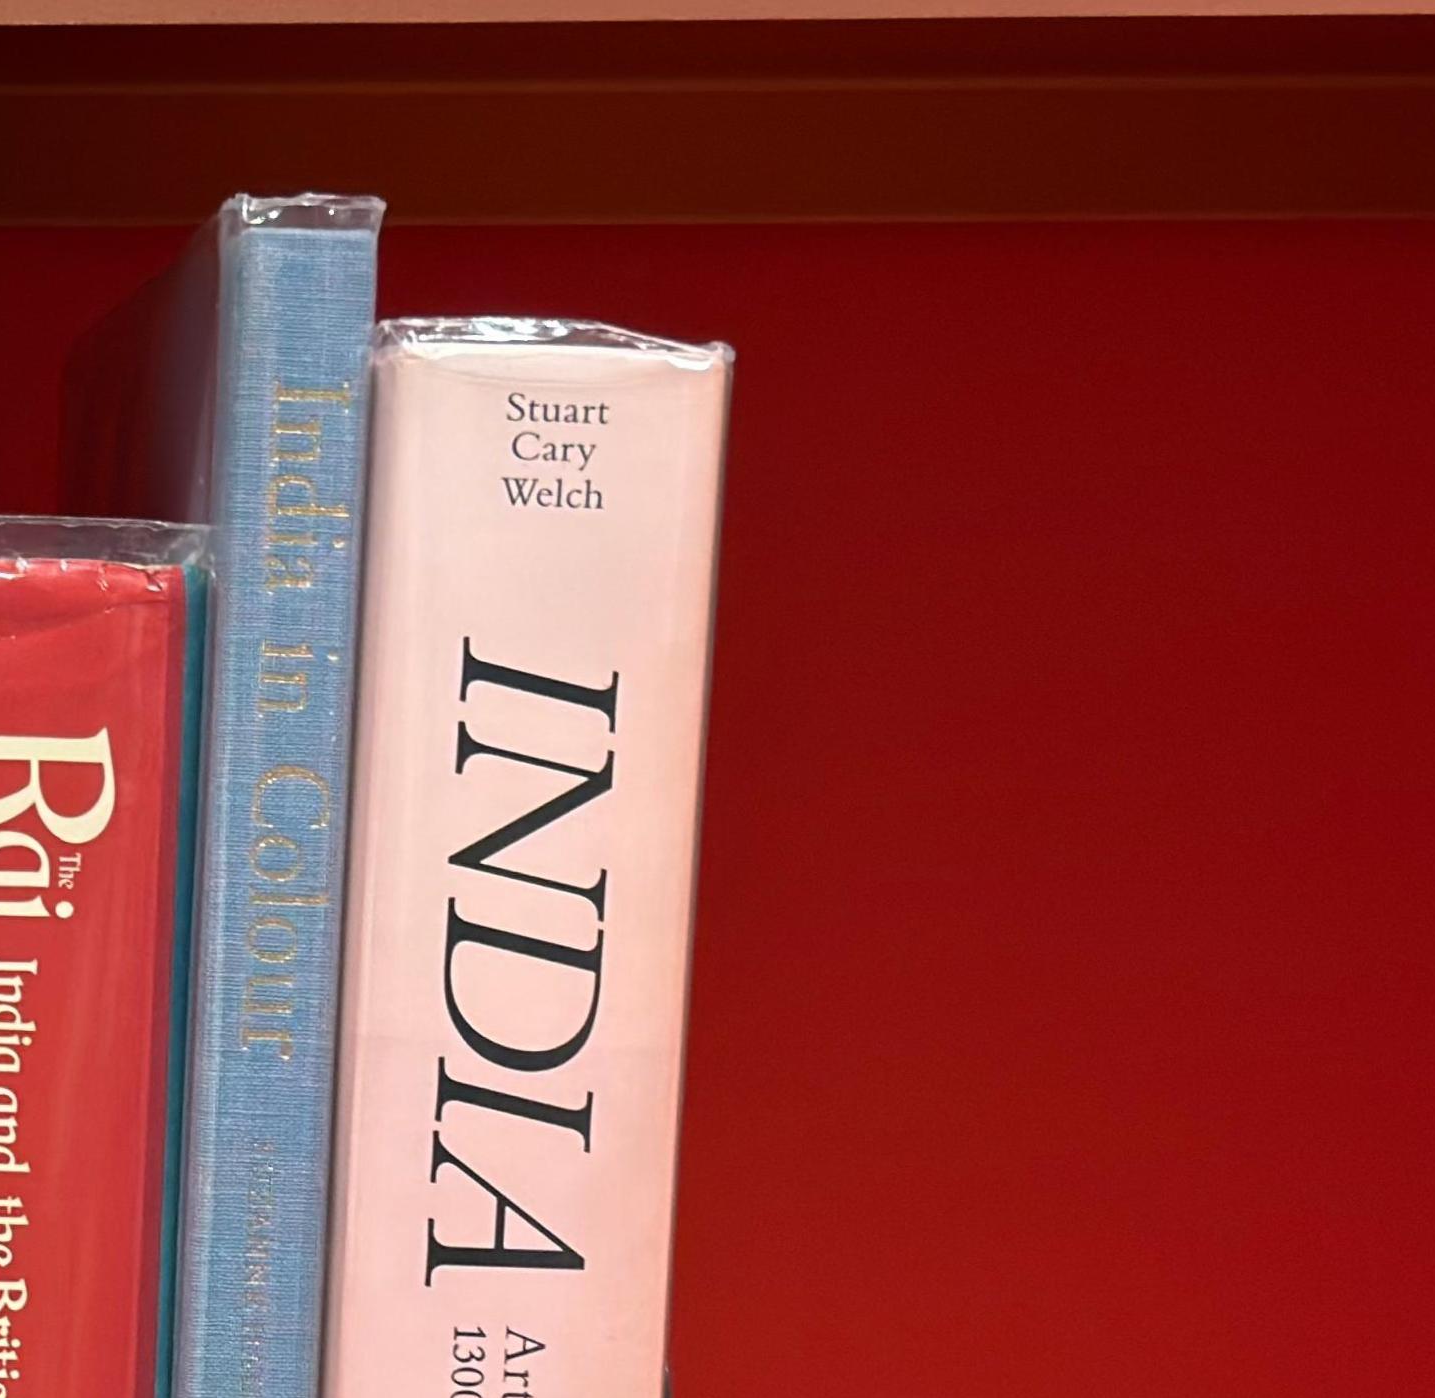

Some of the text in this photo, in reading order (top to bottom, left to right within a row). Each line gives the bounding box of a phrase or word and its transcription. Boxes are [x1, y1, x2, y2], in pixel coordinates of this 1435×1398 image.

[505, 392, 610, 426] Stuart
[510, 431, 598, 471] Cary
[501, 476, 605, 511] Welch
[240, 377, 353, 1066] India in Colour
[57, 851, 83, 891] The
[424, 635, 620, 1288] INDIA
